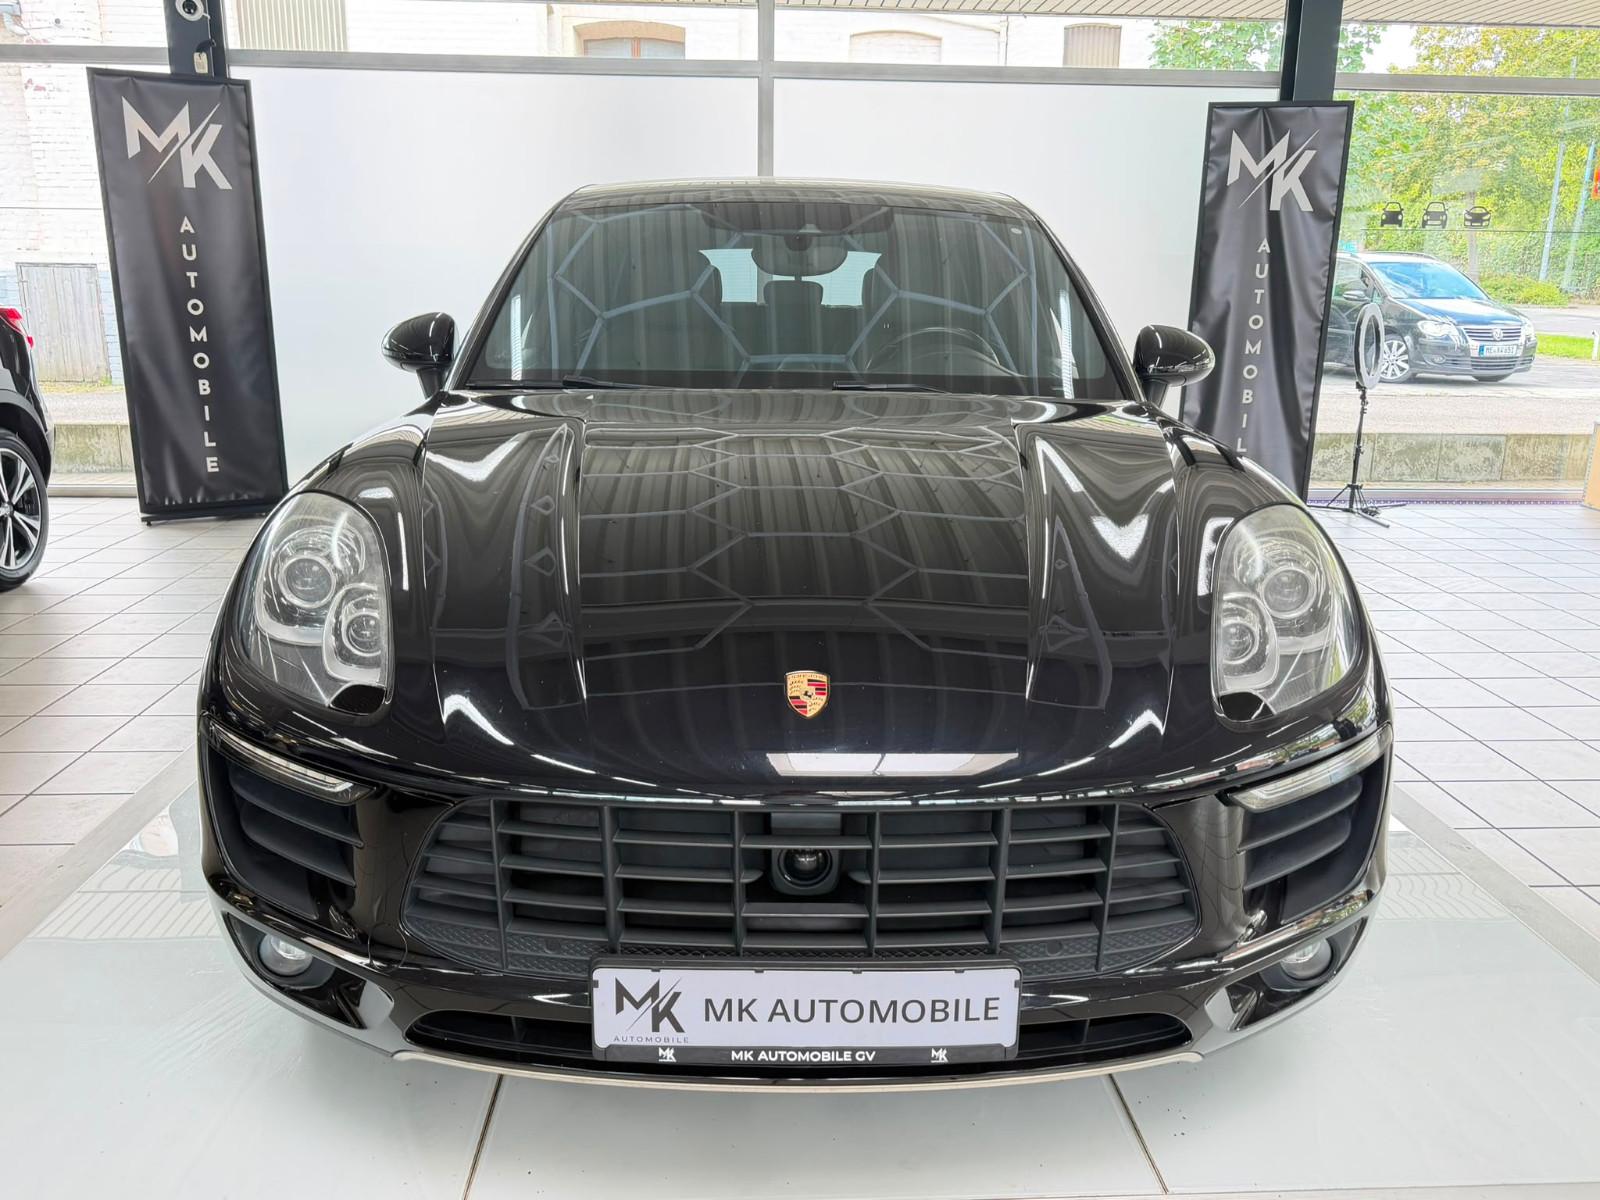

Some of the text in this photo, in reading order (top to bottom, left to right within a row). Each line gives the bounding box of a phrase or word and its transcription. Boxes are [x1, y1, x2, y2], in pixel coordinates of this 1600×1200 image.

[122, 96, 232, 190] MK
[1227, 129, 1320, 212] MK
[180, 215, 221, 473] AUTOMOBILE
[1236, 237, 1271, 453] AUTOMOBIL
[613, 1035, 689, 1044] AUTOMOBILE
[615, 976, 686, 1033] MK
[704, 997, 1000, 1024] MK AUTOMOBILE
[731, 1050, 876, 1062] MK AUTOMOBILE GV
